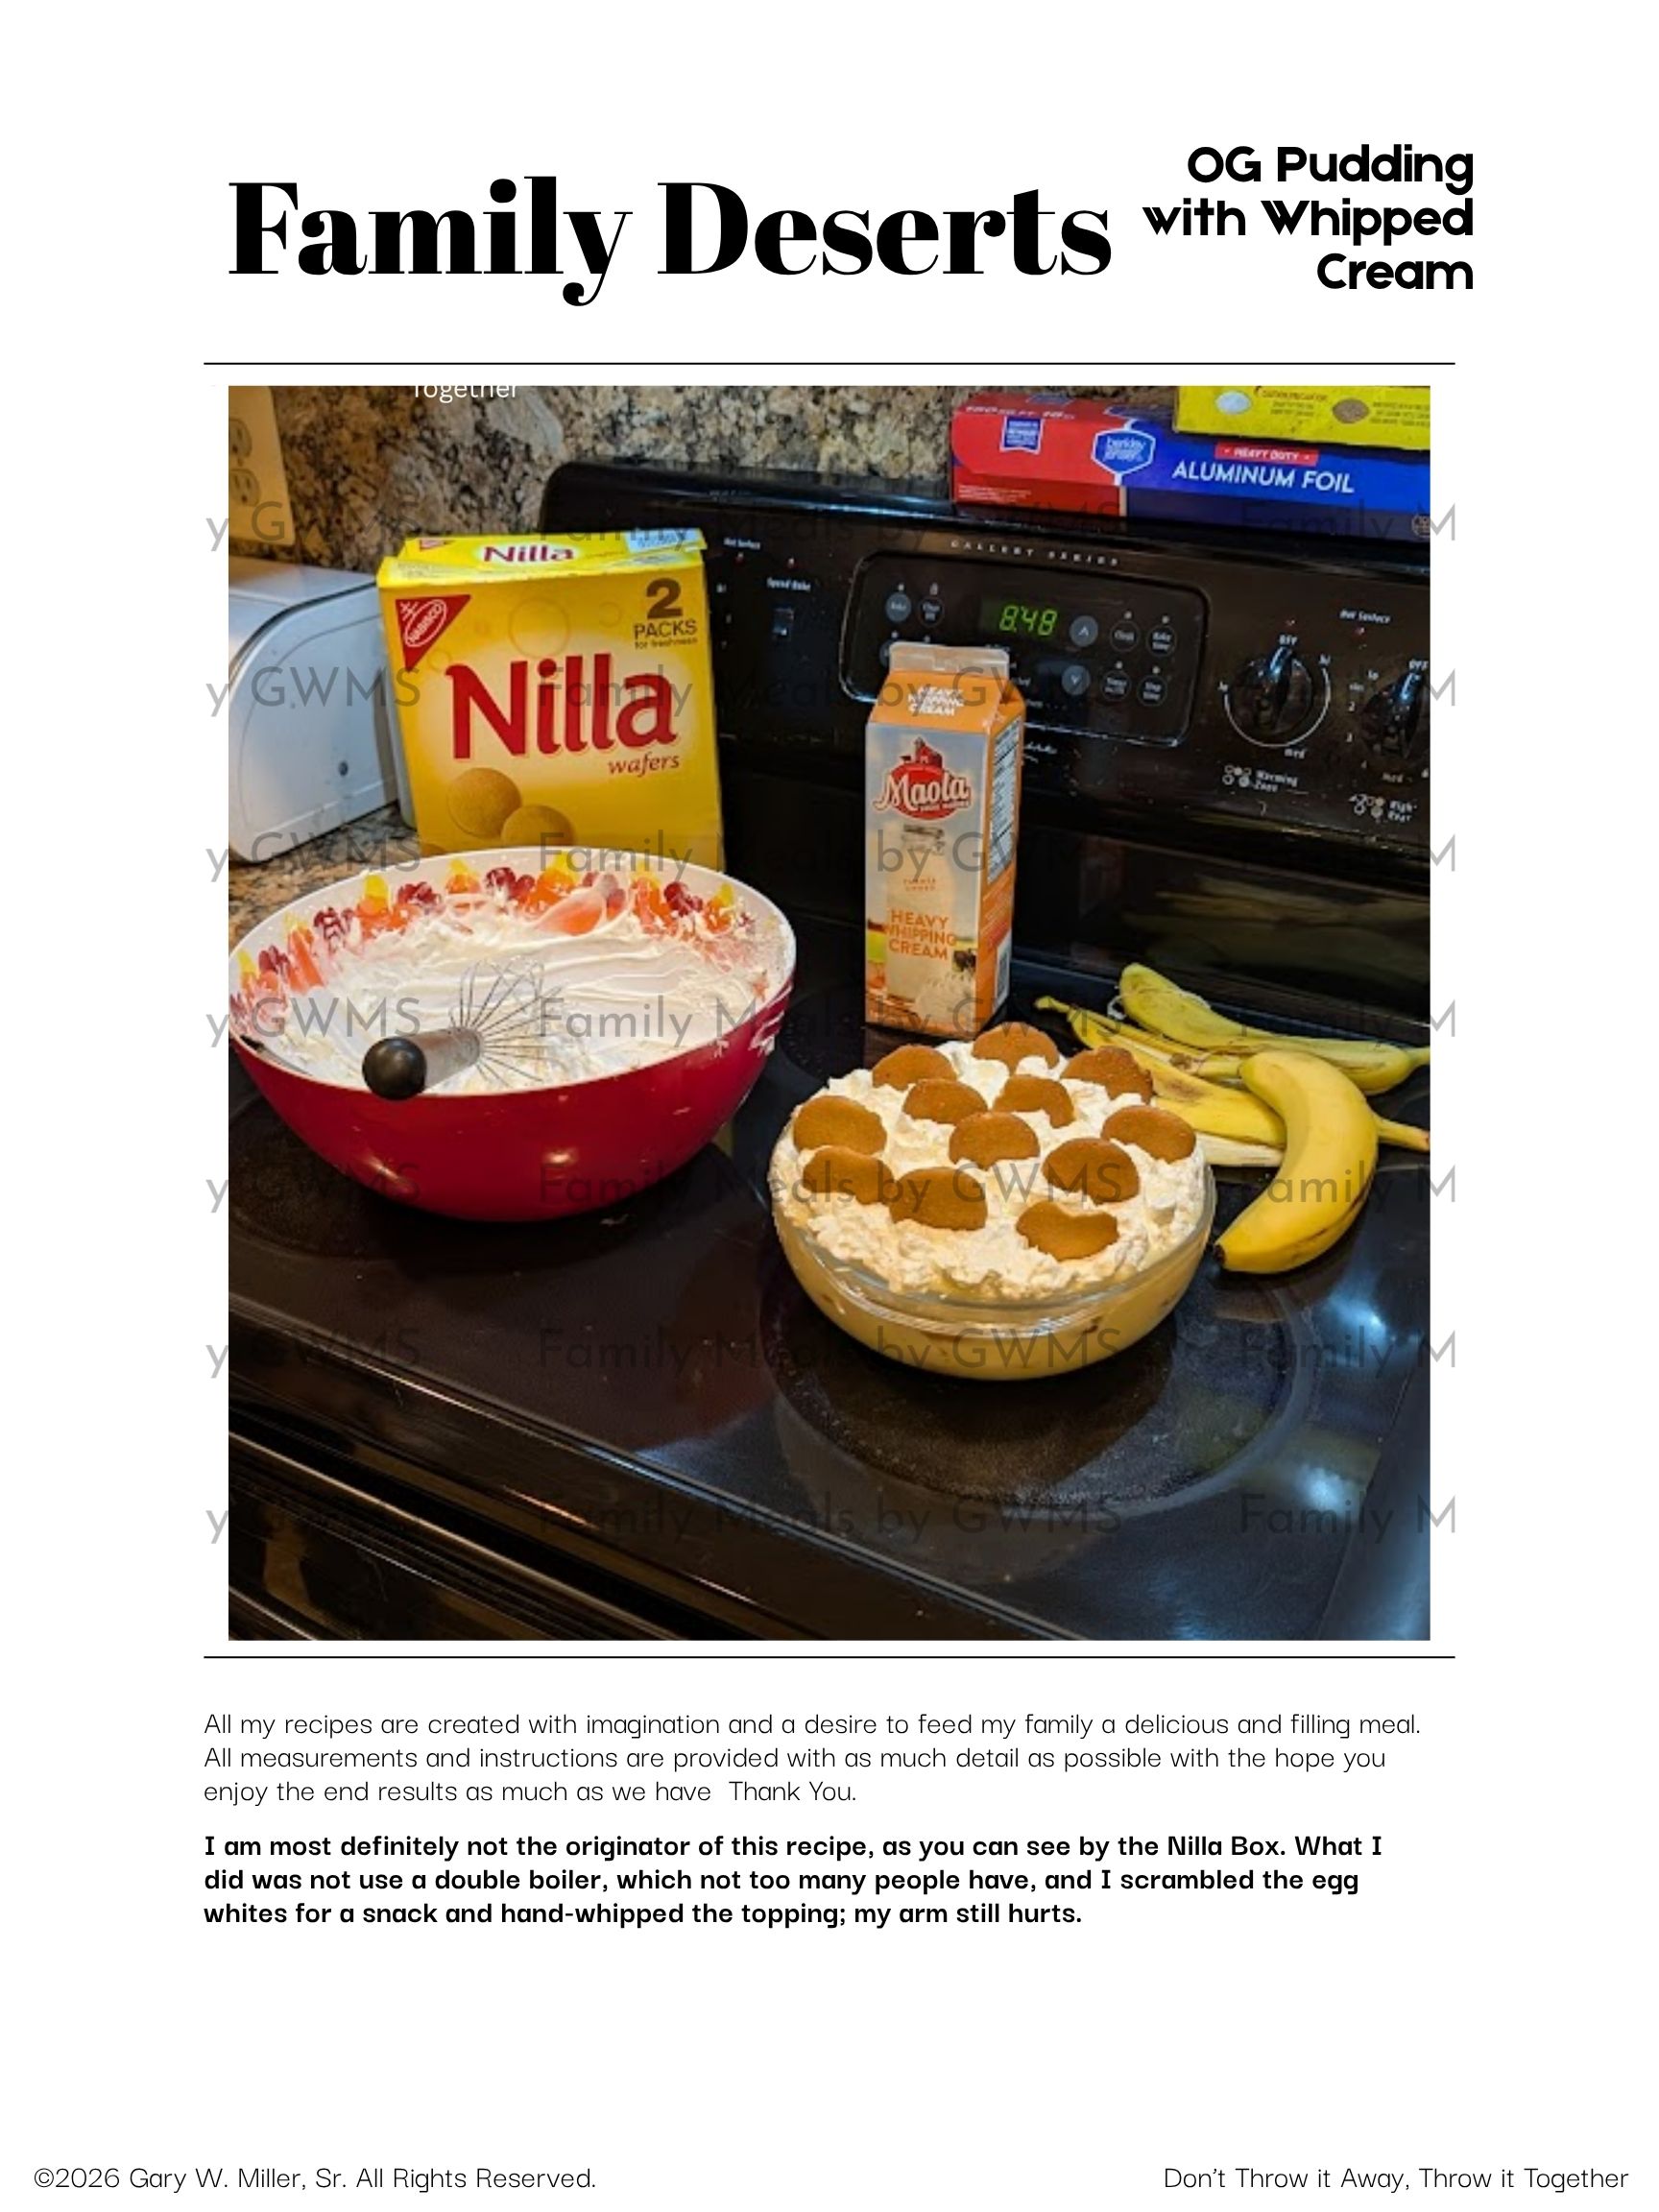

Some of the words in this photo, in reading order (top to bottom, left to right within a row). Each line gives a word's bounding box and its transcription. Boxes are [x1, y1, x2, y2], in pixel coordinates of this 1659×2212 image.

[1187, 145, 1262, 183] OG
[1277, 143, 1474, 196] Pudding
[1142, 197, 1246, 236] with
[1260, 197, 1474, 247] Whipped
[228, 176, 634, 307] Family
[657, 181, 1112, 276] Deserts
[1316, 252, 1474, 290] Cream
[1171, 460, 1296, 489] ALUMINUM
[1302, 470, 1355, 493] FOIL
[483, 544, 577, 564] Nilla
[645, 578, 683, 620] 2
[634, 619, 698, 640] PACKS
[635, 639, 649, 650] for
[445, 652, 678, 760] Nilla
[607, 753, 681, 778] wafers
[873, 771, 972, 813] Maola
[890, 907, 950, 929] HEAVY
[888, 938, 950, 960] CREAM
[204, 1714, 231, 1734] All
[241, 1719, 276, 1740] my
[285, 1715, 373, 1739] recipes
[381, 1719, 419, 1734] are
[428, 1714, 519, 1734] created
[528, 1714, 577, 1734] with
[587, 1715, 720, 1740] imagination
[729, 1714, 773, 1734] and
[781, 1719, 795, 1734] a
[805, 1714, 877, 1734] desire
[886, 1715, 909, 1734] to
[918, 1713, 972, 1734] feed
[981, 1719, 1017, 1740] my
[1024, 1713, 1094, 1740] family
[1101, 1719, 1116, 1734] a
[1125, 1714, 1229, 1734] delicious
[1238, 1714, 1282, 1734] and
[1290, 1713, 1350, 1740] filling
[1359, 1714, 1420, 1734] meal.
[204, 1747, 231, 1767] All
[241, 1748, 418, 1767] measurements
[426, 1747, 470, 1767] and
[480, 1748, 617, 1767] instructions
[626, 1752, 664, 1767] are
[674, 1747, 779, 1773] provided
[786, 1747, 835, 1767] with
[845, 1752, 872, 1767] as
[880, 1747, 947, 1767] much
[956, 1747, 1019, 1767] detail
[1028, 1752, 1055, 1767] as
[1065, 1747, 1162, 1773] possible
[1170, 1747, 1218, 1767] with
[1228, 1747, 1265, 1767] the
[1275, 1747, 1334, 1773] hope
[1343, 1752, 1385, 1773] you
[204, 1836, 215, 1856] I
[224, 1840, 261, 1856] am
[270, 1837, 331, 1856] most
[340, 1835, 460, 1863] definitely
[468, 1837, 508, 1856] not
[516, 1836, 558, 1856] the
[565, 1835, 690, 1862] originator
[698, 1835, 724, 1856] of
[731, 1835, 779, 1856] this
[786, 1835, 874, 1862] recipe,
[882, 1839, 911, 1856] as
[918, 1840, 965, 1863] you
[973, 1840, 1019, 1856] can
[1026, 1840, 1070, 1856] see
[1079, 1836, 1110, 1863] by
[1118, 1836, 1159, 1856] the
[1167, 1835, 1222, 1856] Nilla
[1231, 1836, 1286, 1856] Box.
[1294, 1836, 1362, 1856] What
[1372, 1836, 1382, 1856] I
[204, 1868, 244, 1889] did
[252, 1874, 302, 1889] was
[310, 1870, 351, 1889] not
[359, 1873, 403, 1889] use
[411, 1874, 426, 1889] a
[435, 1869, 520, 1889] double
[529, 1868, 608, 1892] boiler,
[616, 1868, 692, 1889] which
[700, 1870, 741, 1889] not
[749, 1870, 790, 1889] too
[799, 1874, 867, 1896] many
[875, 1869, 960, 1895] people
[969, 1869, 1036, 1892] have,
[1045, 1869, 1092, 1889] and
[1101, 1869, 1111, 1889] I
[1120, 1869, 1254, 1889] scrambled
[1262, 1869, 1304, 1889] the
[1311, 1874, 1358, 1895] egg
[203, 1902, 287, 1923] whites
[295, 1902, 332, 1923] for
[339, 1908, 354, 1923] a
[363, 1903, 438, 1923] snack
[445, 1903, 493, 1923] and
[501, 1902, 684, 1929] hand-whipped
[691, 1903, 733, 1923] the
[741, 1902, 846, 1929] topping;
[854, 1908, 892, 1930] my
[899, 1908, 948, 1923] arm
[956, 1902, 999, 1923] still
[1008, 1903, 1082, 1923] hurts.
[34, 2167, 120, 2189] ©2026
[130, 2167, 187, 2194] Gary
[195, 2168, 228, 2188] W.
[238, 2168, 306, 2191] Miller,
[315, 2167, 347, 2189] Sr.
[355, 2168, 383, 2188] All
[394, 2168, 467, 2194] Rights
[476, 2168, 595, 2188] Reserved.
[1165, 2168, 1226, 2188] Don’t
[1235, 2168, 1309, 2188] Throw
[1317, 2169, 1331, 2188] it
[1340, 2168, 1409, 2194] Away,
[1418, 2168, 1492, 2188] Throw
[1502, 2169, 1515, 2188] it
[1524, 2168, 1629, 2194] Together
